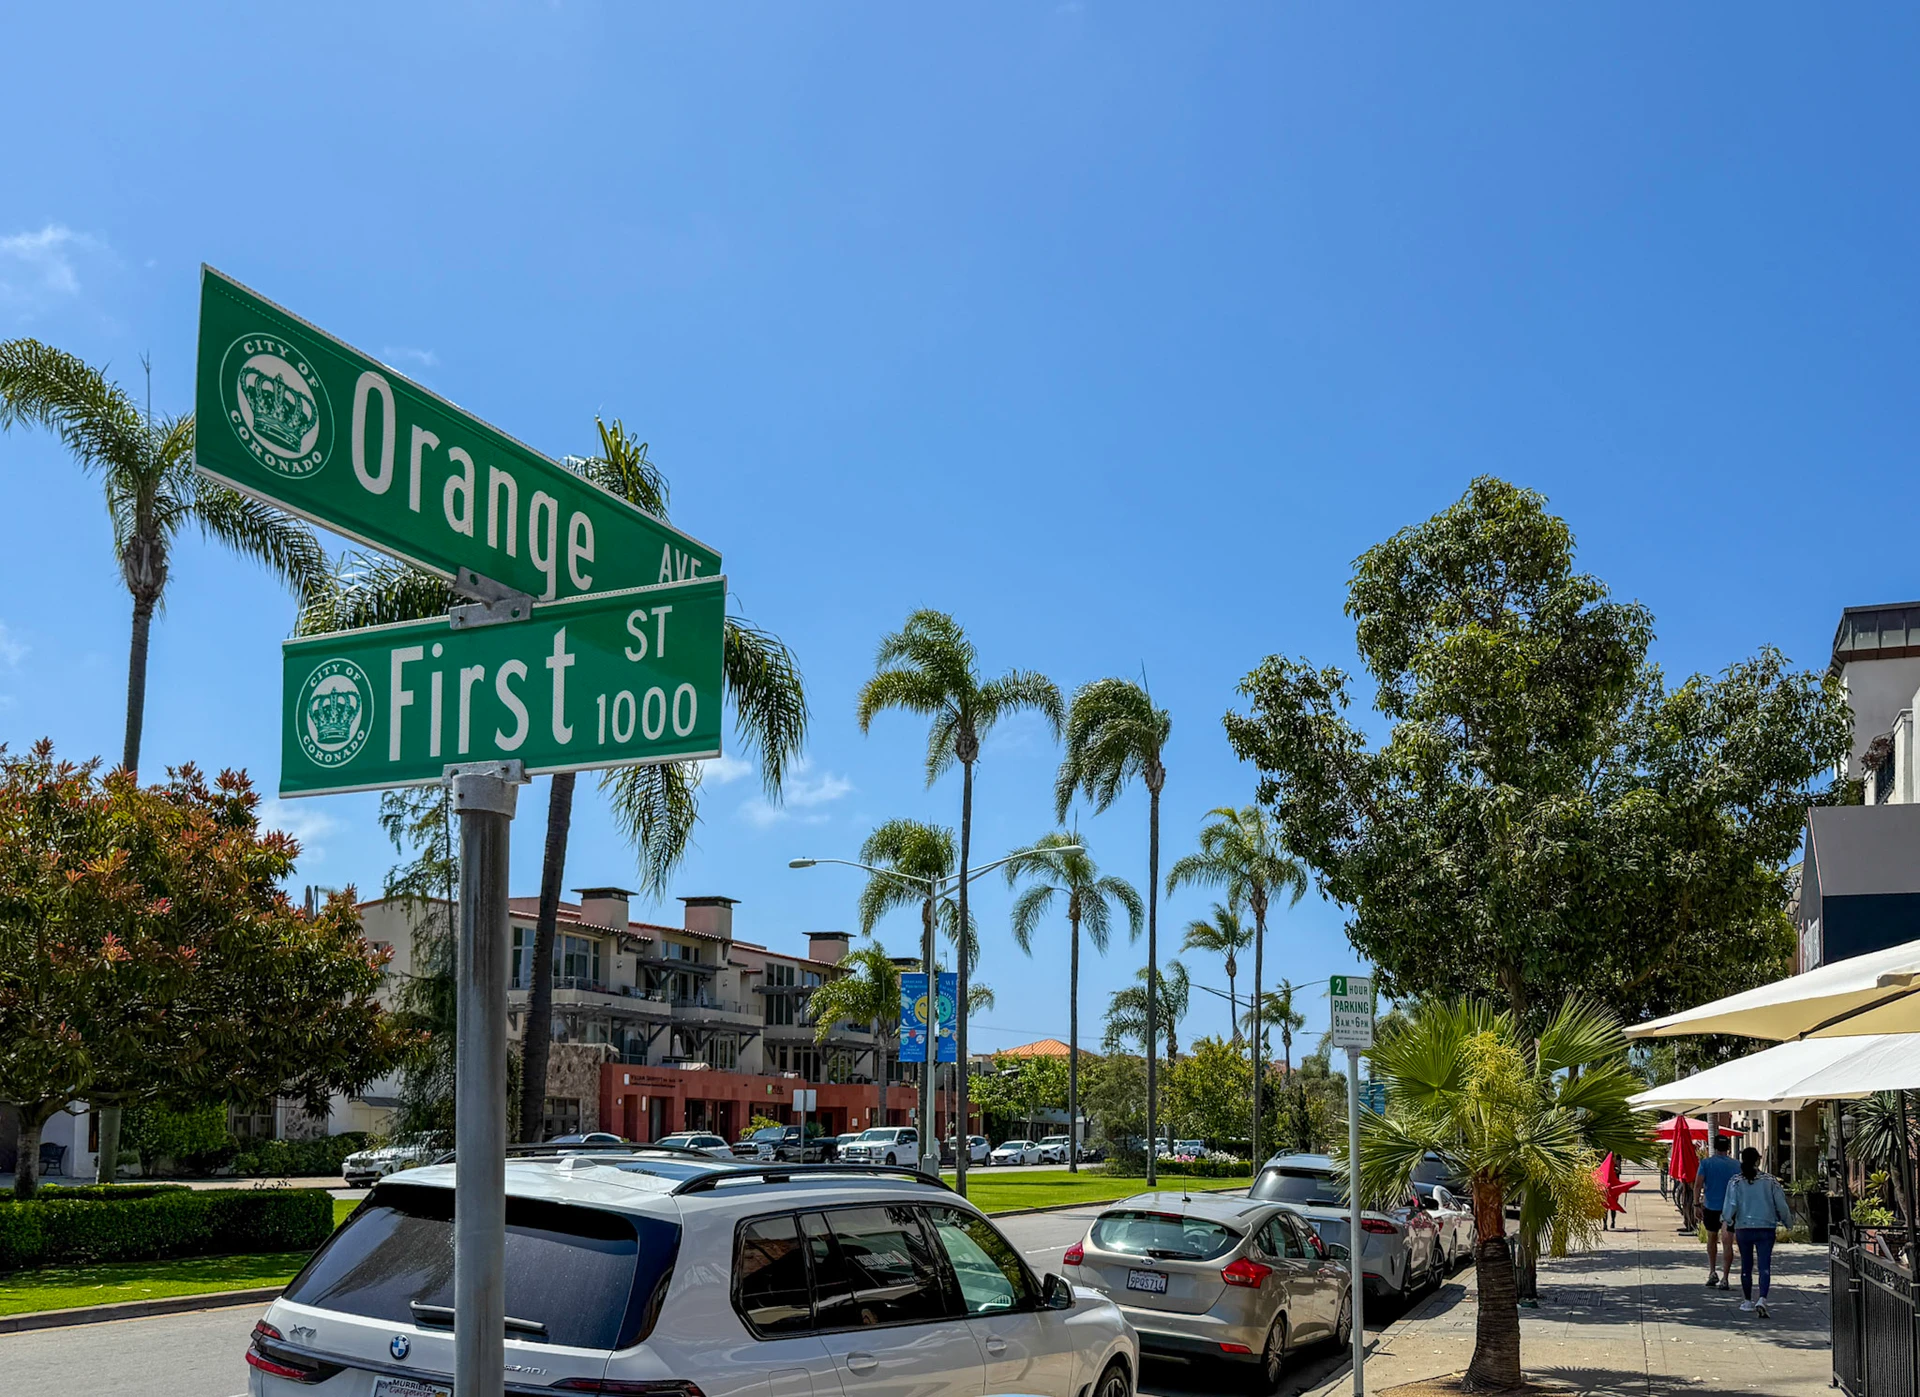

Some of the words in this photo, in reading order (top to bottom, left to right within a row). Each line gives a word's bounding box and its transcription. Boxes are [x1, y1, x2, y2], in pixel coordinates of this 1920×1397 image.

[244, 340, 289, 357] CITY
[298, 362, 319, 388] OF
[230, 410, 322, 473] CORONADO
[352, 371, 595, 600] Orange
[310, 664, 340, 687] CITY
[345, 667, 361, 681] OF
[389, 626, 575, 761] First
[624, 606, 673, 662] ST
[597, 683, 698, 745] 1000
[303, 729, 365, 763] CORONADO
[1335, 979, 1342, 993] 2
[1349, 985, 1368, 995] HOUR
[1334, 1000, 1369, 1014] PARKING
[289, 1324, 316, 1337] X7
[392, 1379, 433, 1392] MURRIETA
